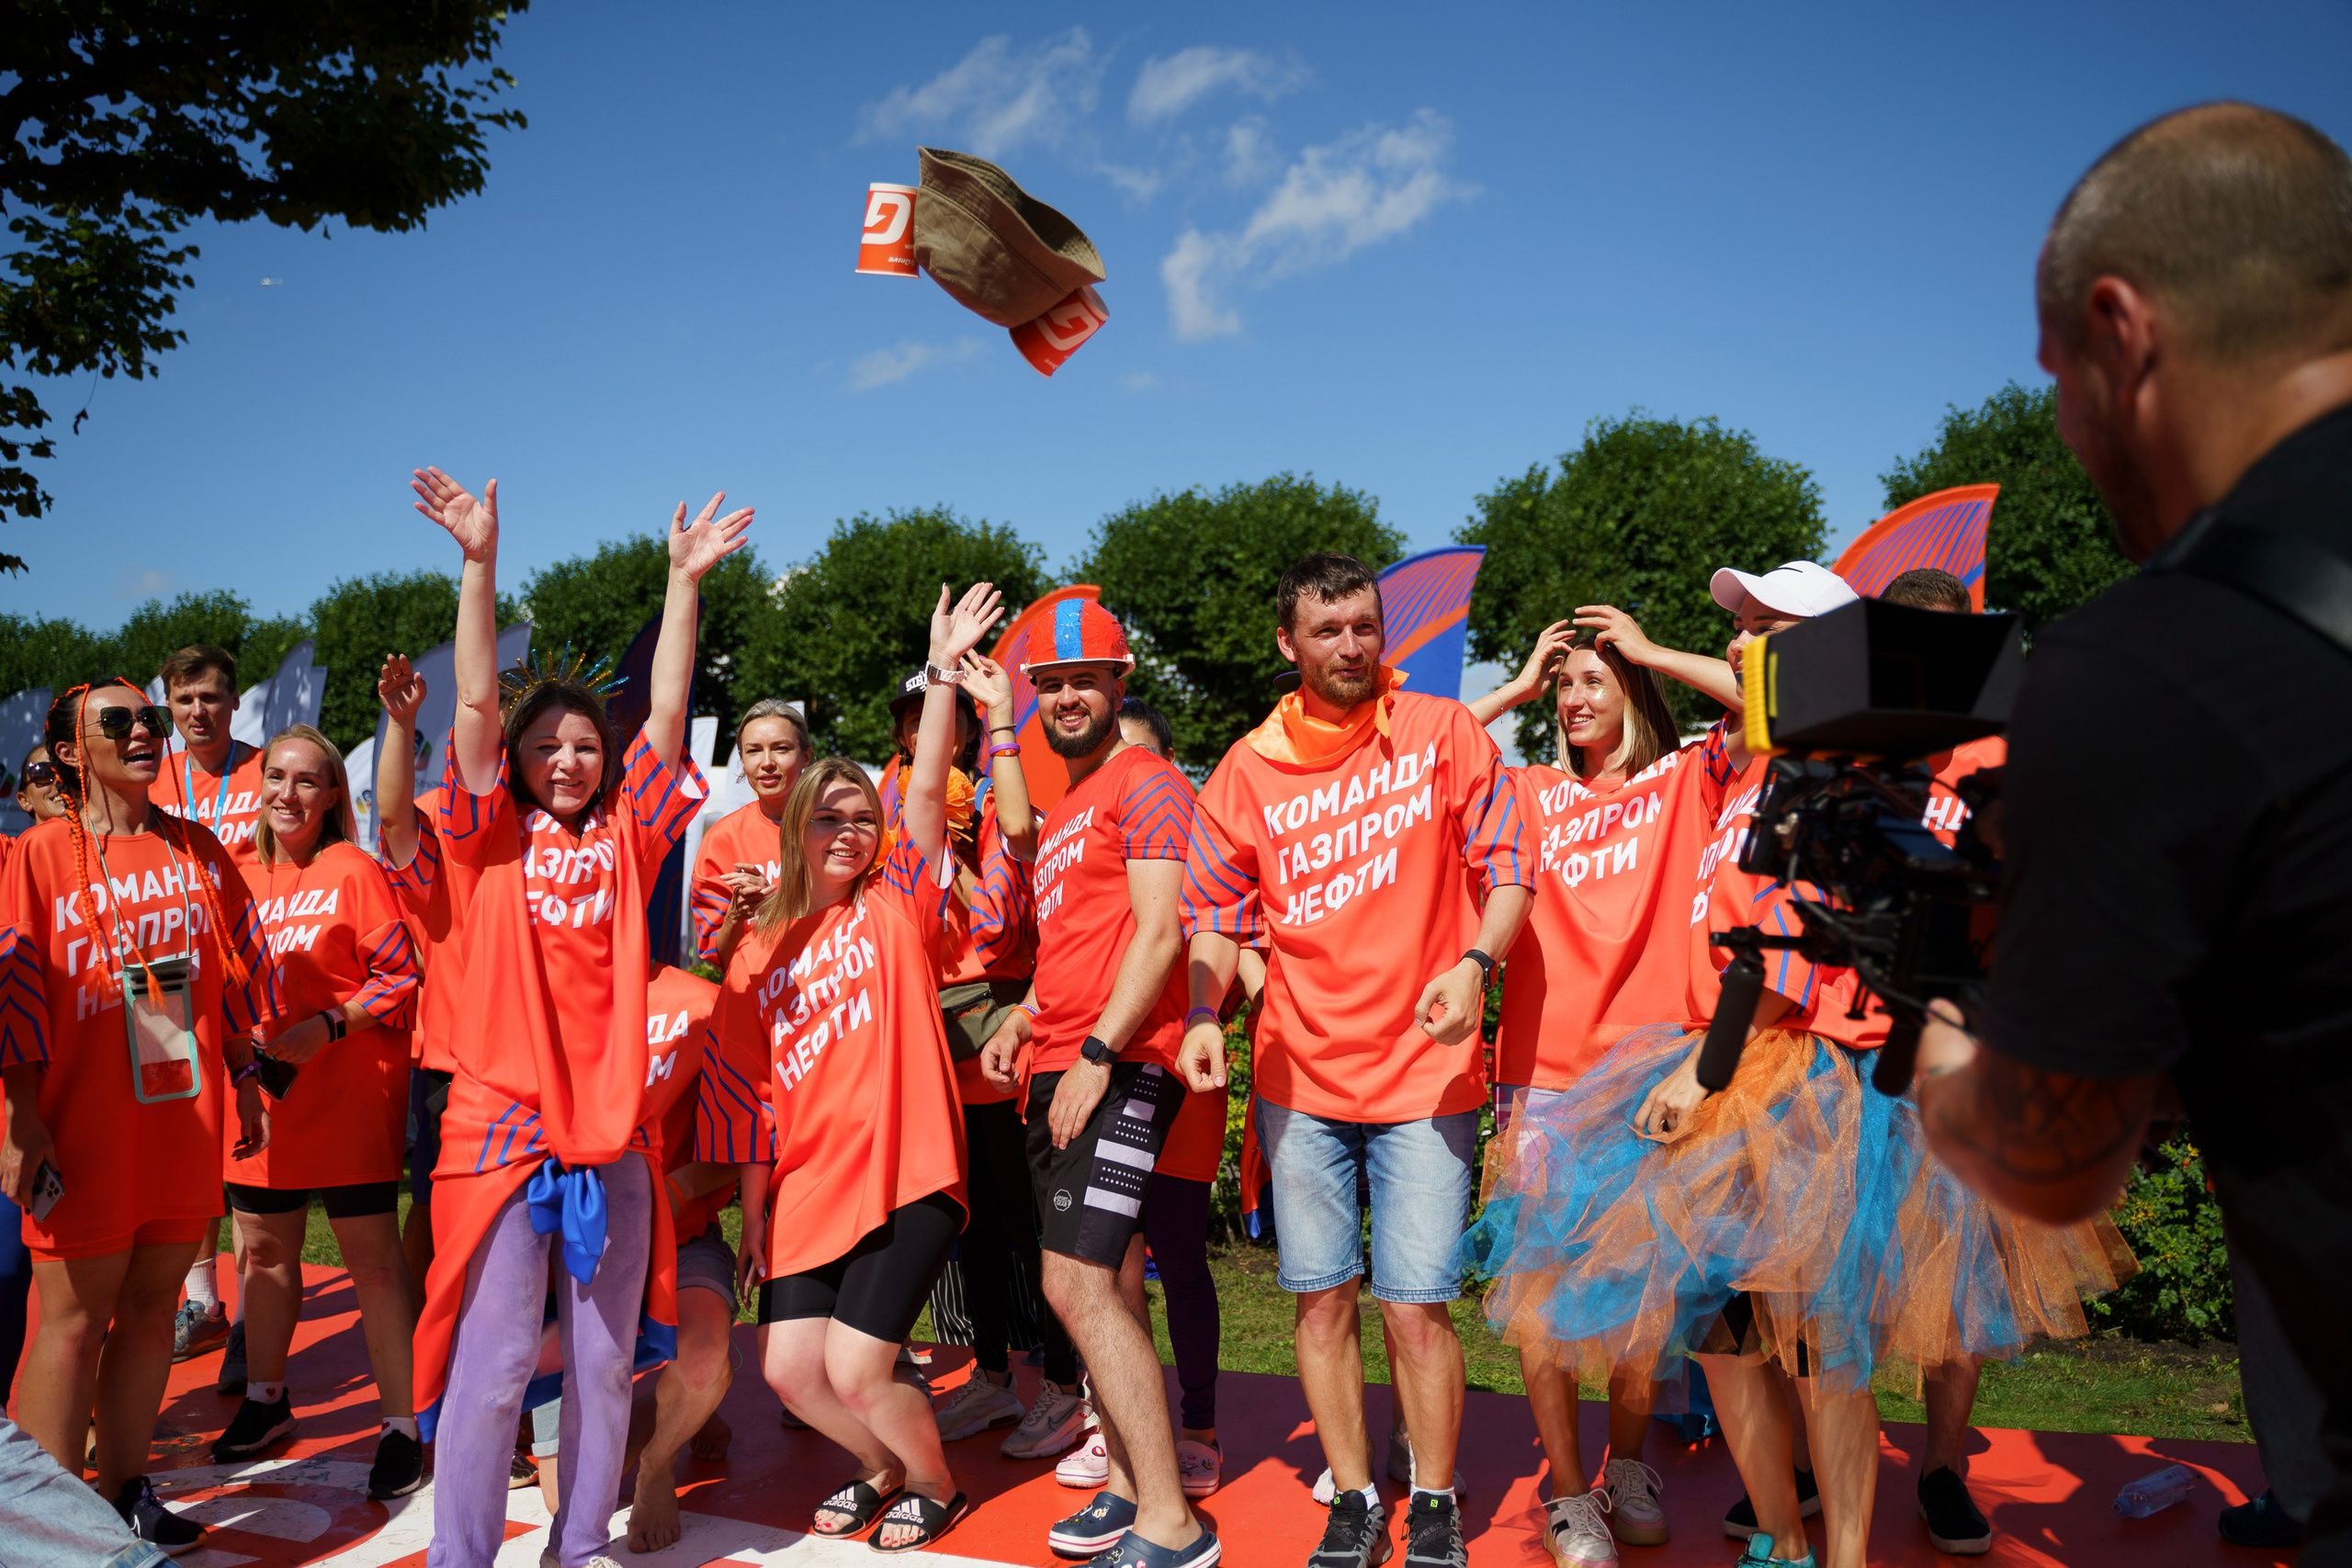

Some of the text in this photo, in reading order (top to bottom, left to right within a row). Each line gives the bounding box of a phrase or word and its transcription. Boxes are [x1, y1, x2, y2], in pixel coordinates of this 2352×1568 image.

[1263, 740, 1436, 840] КОМАНДА
[1035, 806, 1095, 867] ОМАНДА
[1278, 784, 1432, 886] ГАЗПРОМ
[1544, 791, 1663, 852] АЗПРОМ
[1033, 838, 1085, 900] АЗПРОМ
[1280, 847, 1397, 926] НЕФТИ
[526, 886, 615, 929] ЕФТИ
[1036, 880, 1064, 925] ЕФТИ
[771, 936, 875, 1048] АЗПРОМ
[775, 987, 873, 1092] НЕФТИ
[823, 1498, 858, 1512] adidas
[886, 1510, 924, 1524] adidas
